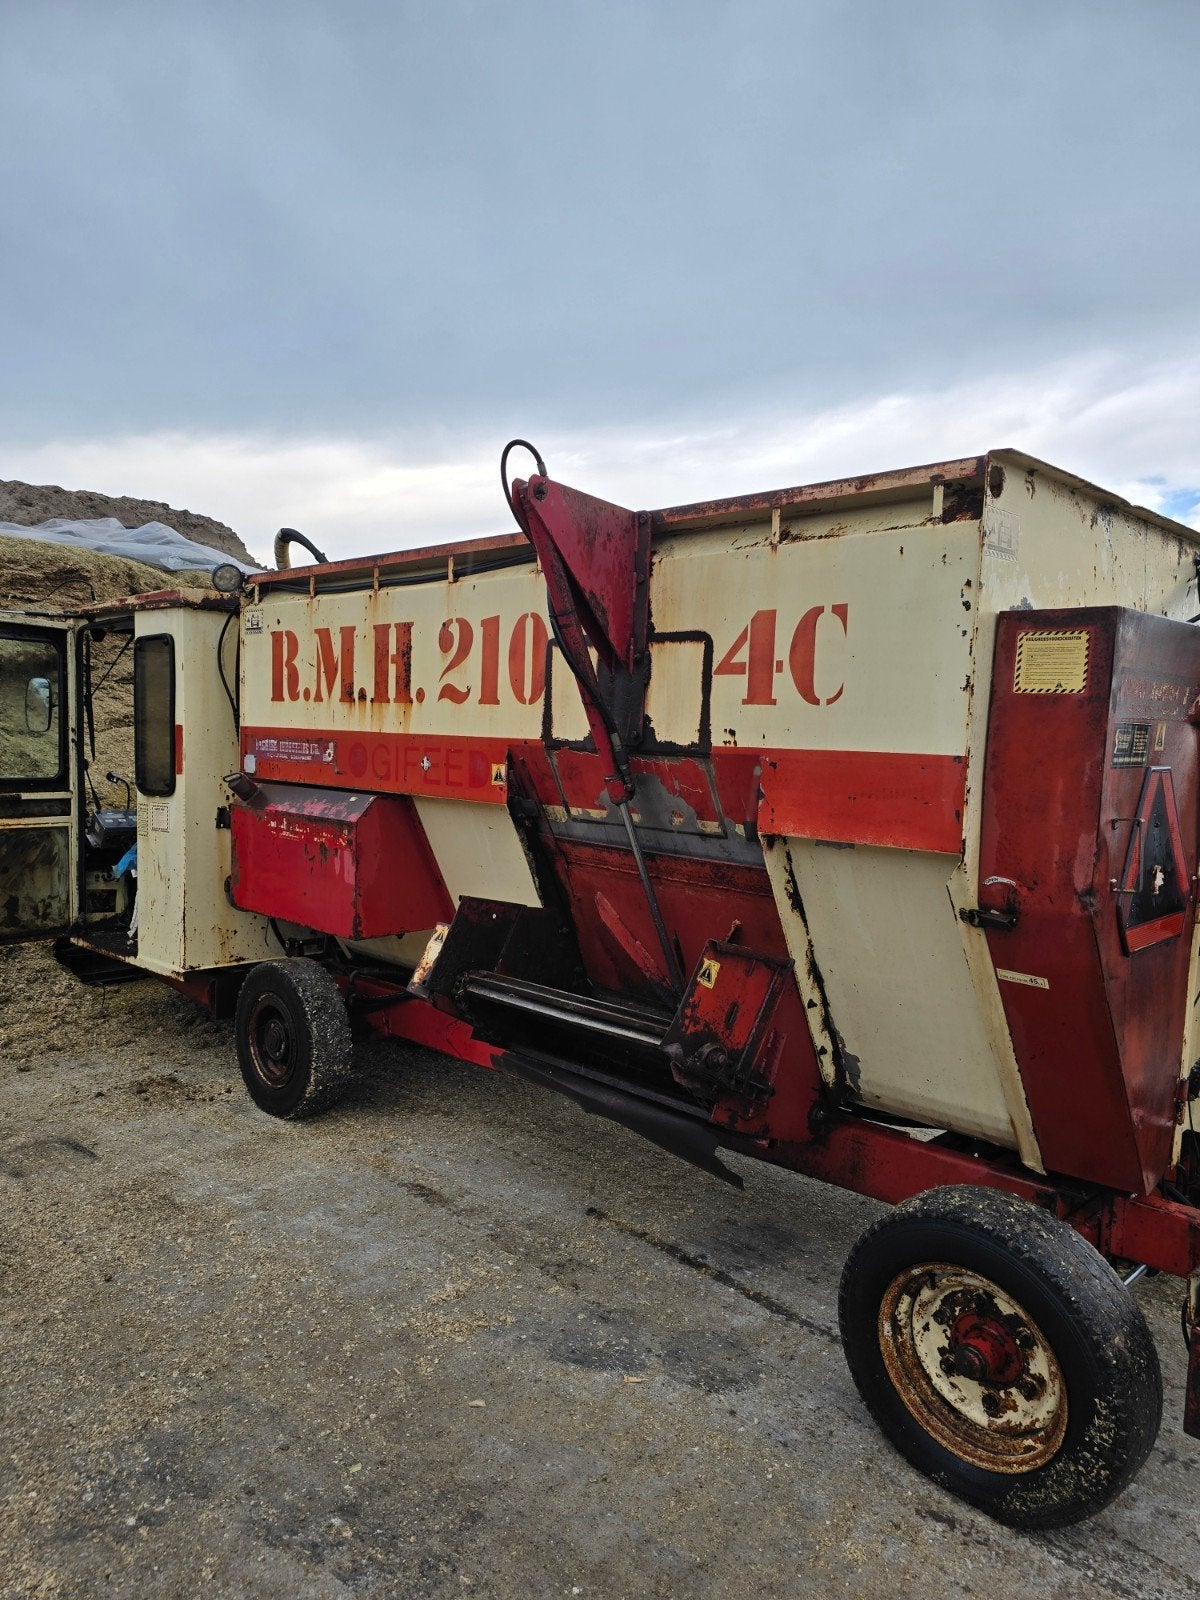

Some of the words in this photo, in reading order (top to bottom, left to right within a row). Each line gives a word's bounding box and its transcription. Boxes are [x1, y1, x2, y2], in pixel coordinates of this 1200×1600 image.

[271, 621, 426, 704] R.M.H.
[438, 612, 549, 706] 210
[713, 603, 849, 706] 4C
